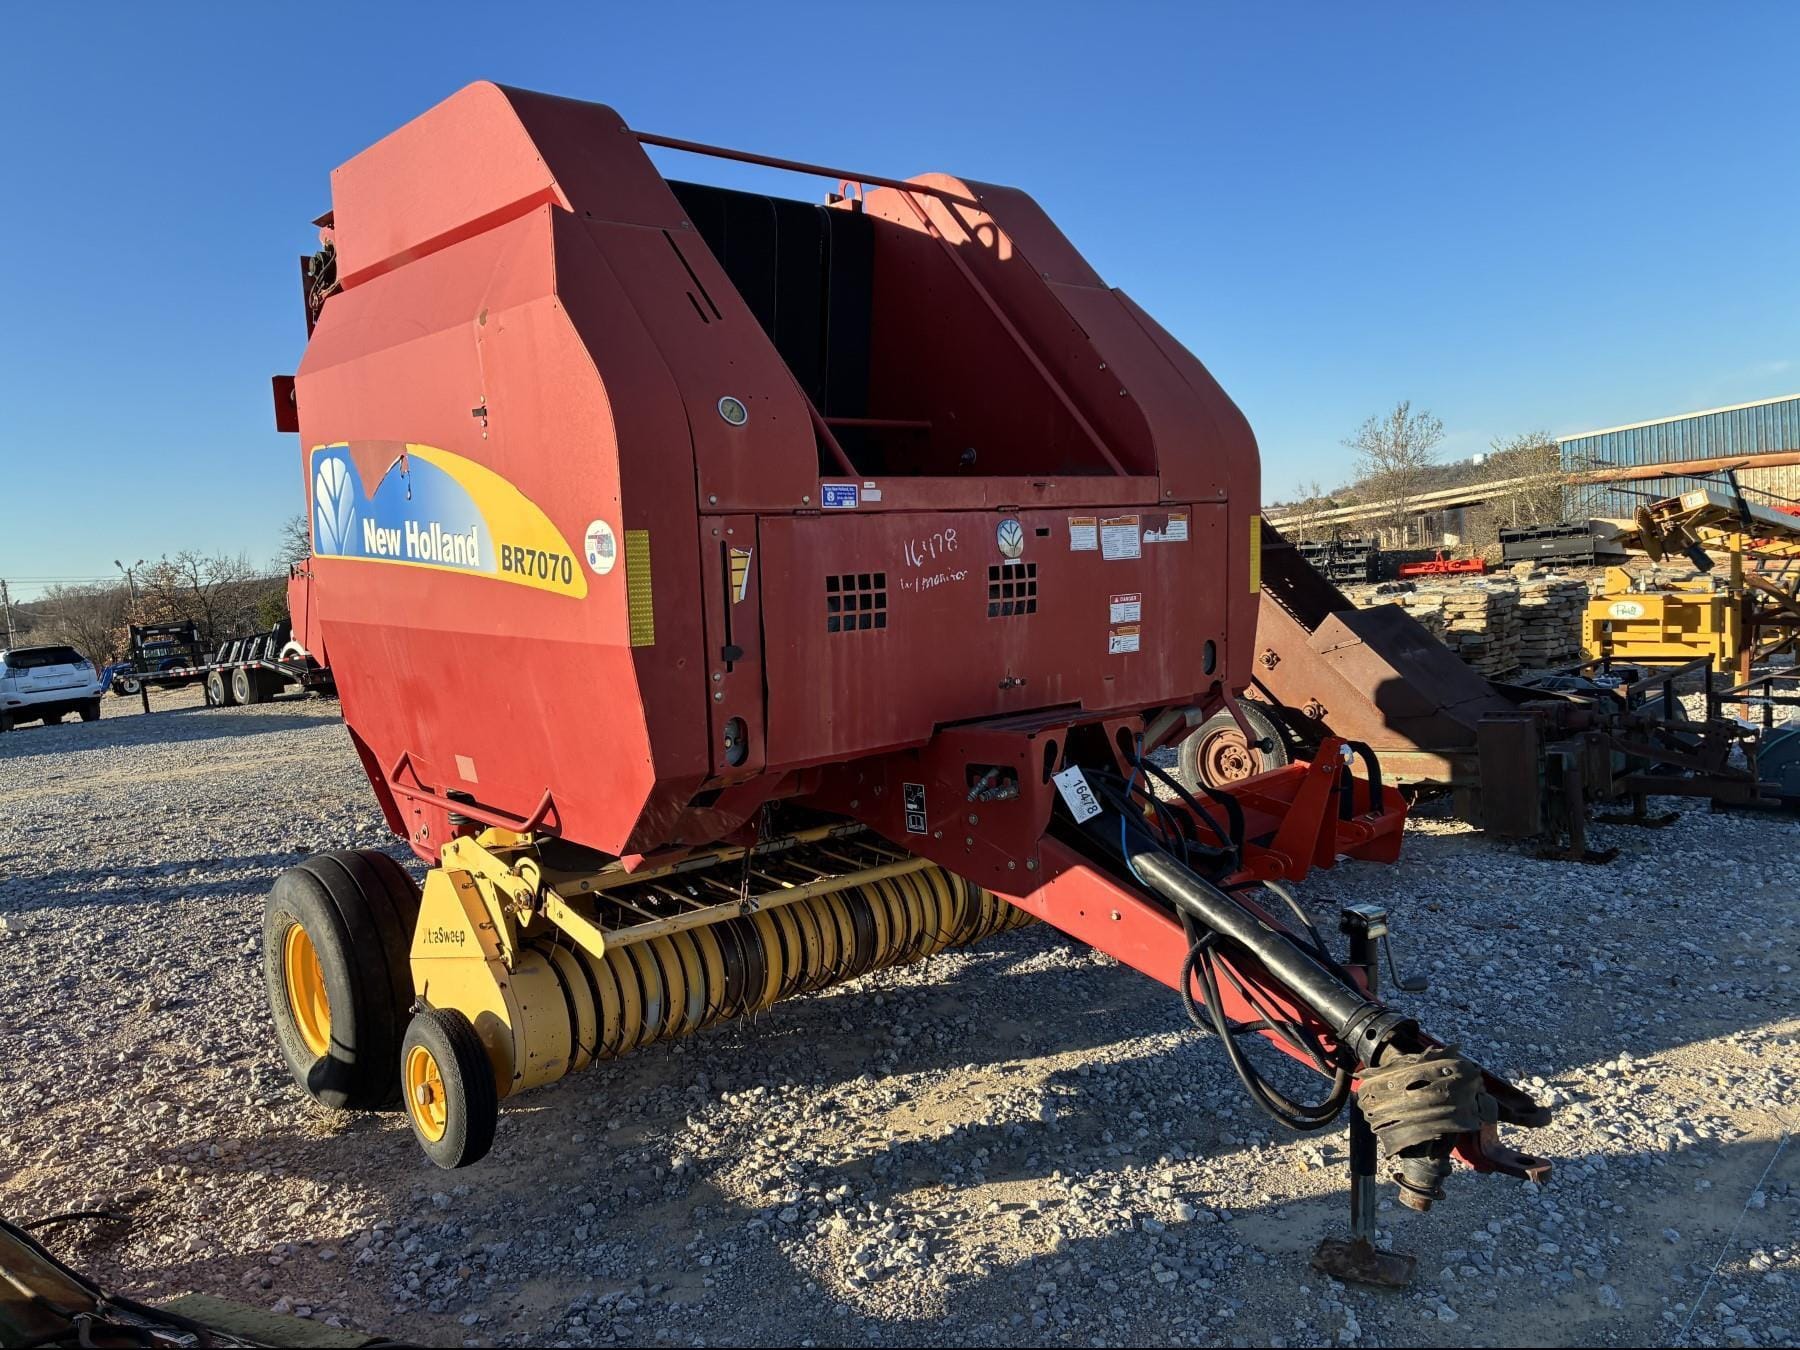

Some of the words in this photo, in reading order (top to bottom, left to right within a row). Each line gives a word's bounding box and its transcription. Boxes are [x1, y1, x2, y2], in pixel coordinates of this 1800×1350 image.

[363, 518, 401, 556] New
[404, 520, 480, 567] Holland
[501, 544, 573, 585] BR7070
[1073, 779, 1098, 814] 16478
